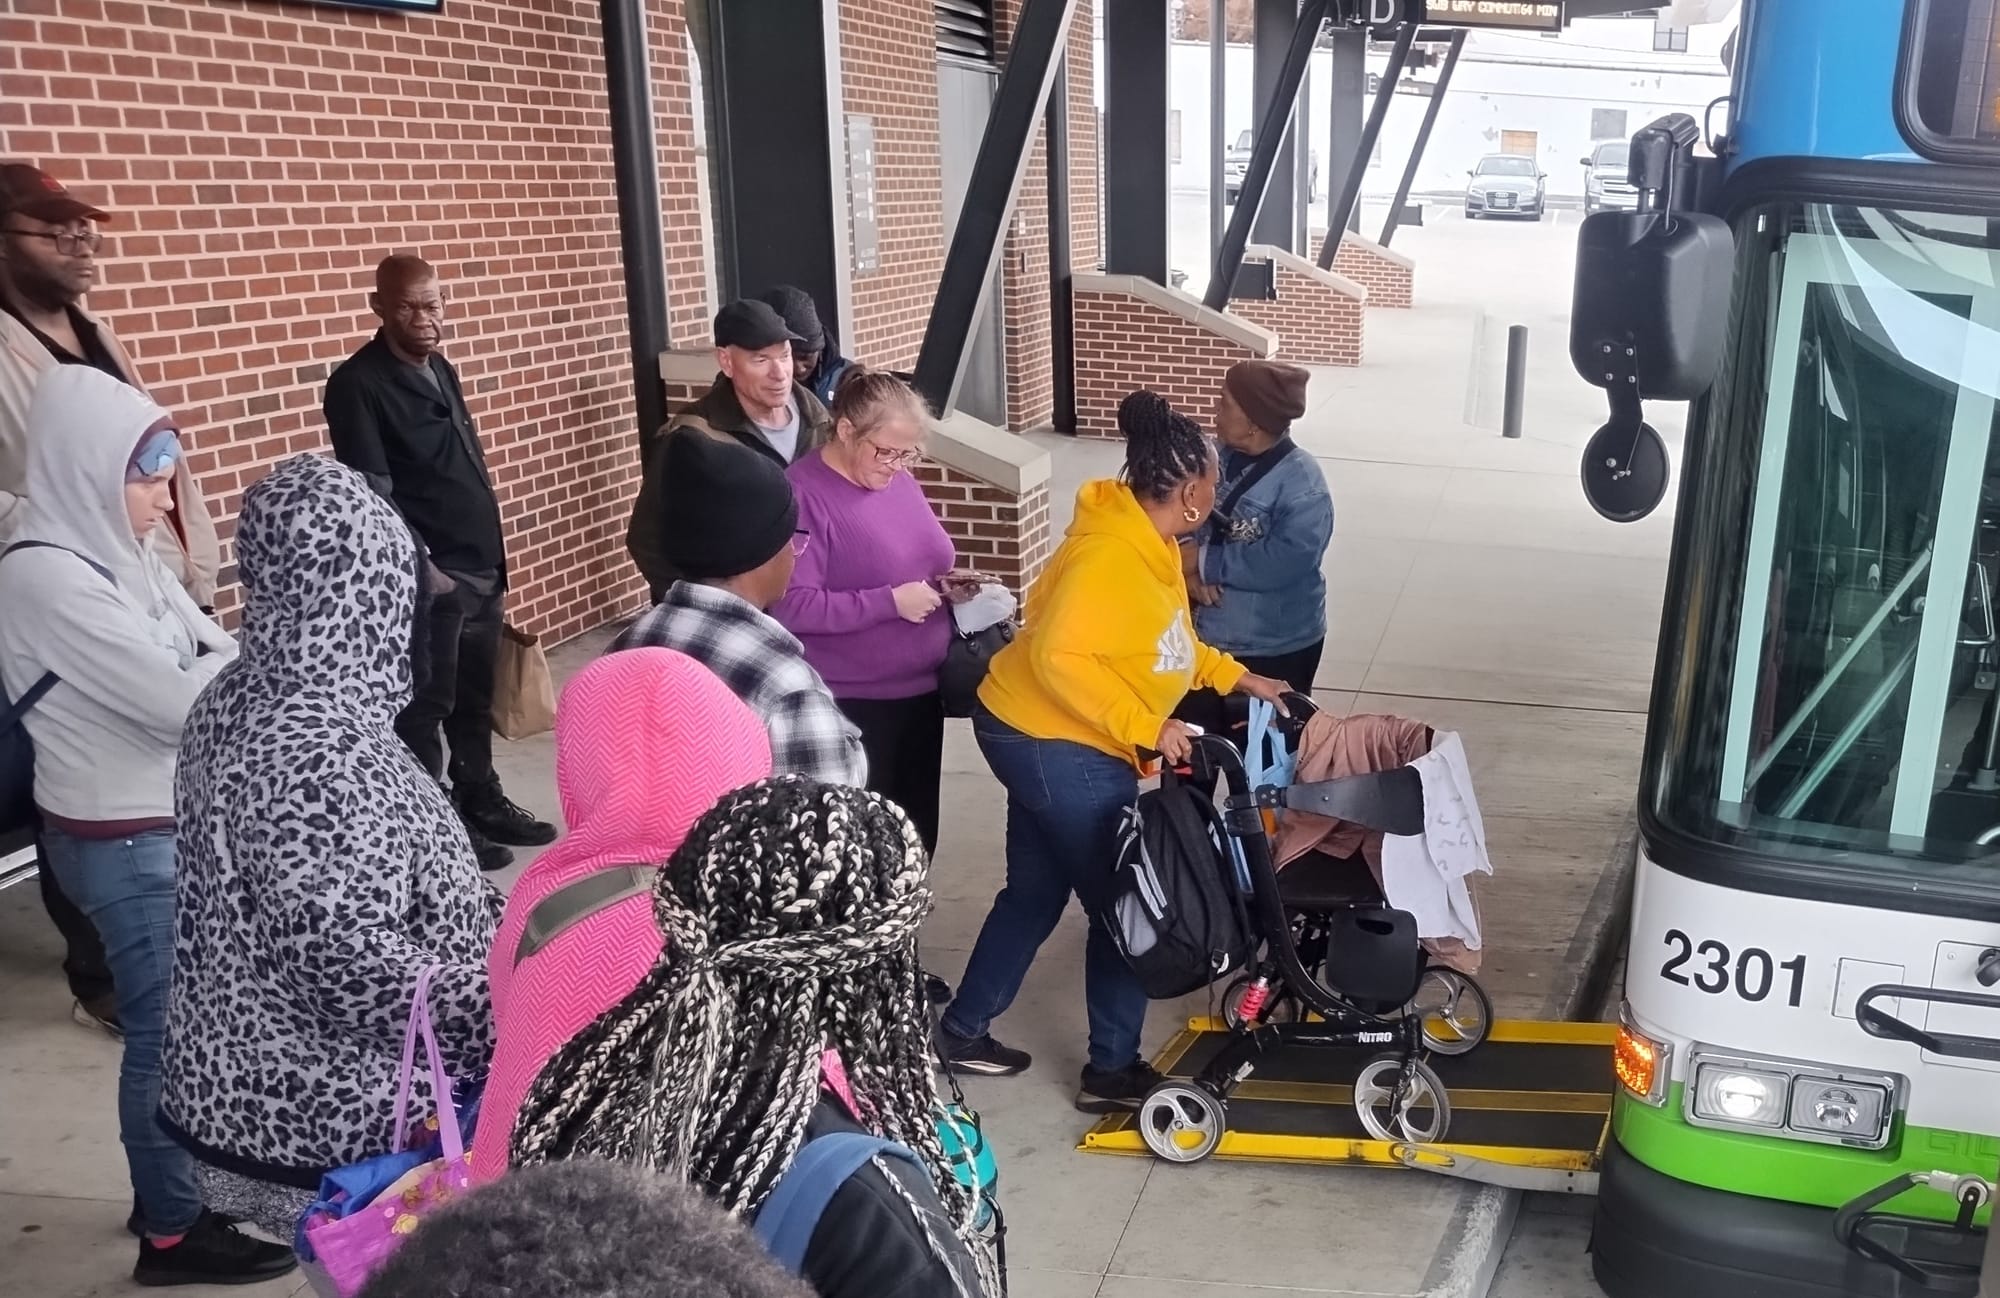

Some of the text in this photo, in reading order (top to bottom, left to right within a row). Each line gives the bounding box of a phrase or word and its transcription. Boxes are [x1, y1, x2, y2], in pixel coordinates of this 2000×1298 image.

[1370, 0, 1395, 24] D
[1536, 5, 1558, 17] MIN
[1660, 928, 1807, 1008] 2301
